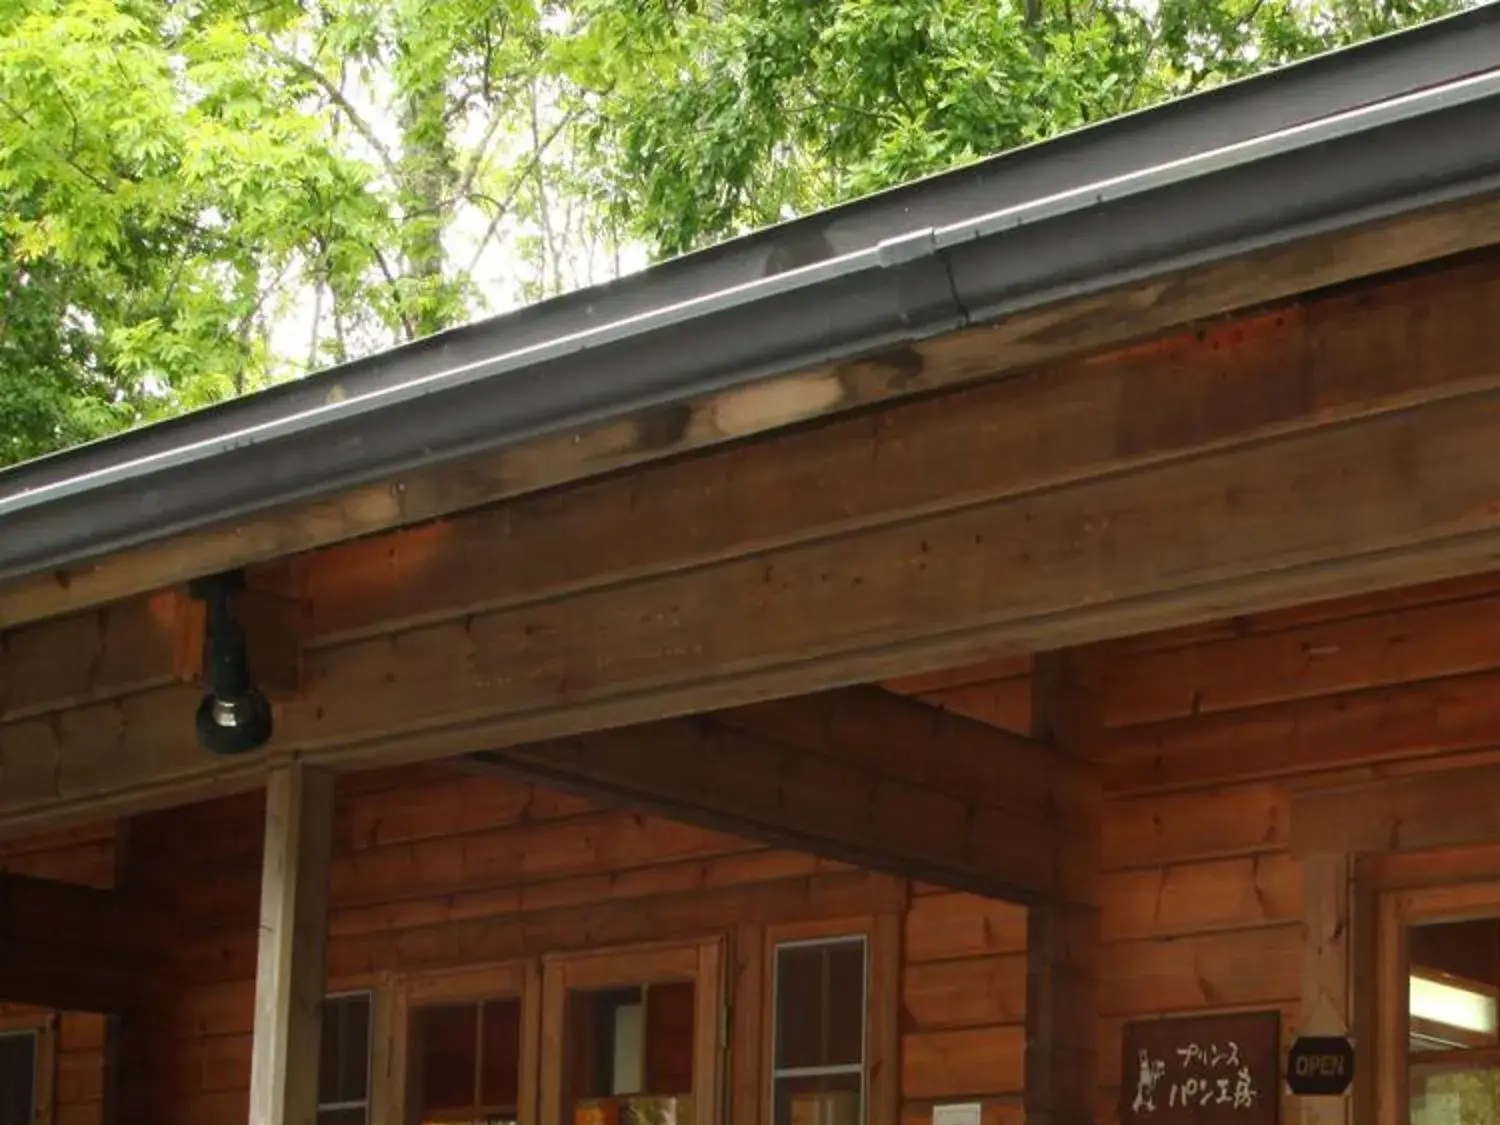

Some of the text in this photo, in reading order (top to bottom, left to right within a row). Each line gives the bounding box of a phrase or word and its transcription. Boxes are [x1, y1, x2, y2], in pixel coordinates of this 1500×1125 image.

[1175, 1041, 1240, 1067] プリンス
[1296, 1055, 1345, 1076] OPEN
[1169, 1065, 1257, 1110] パン工房
